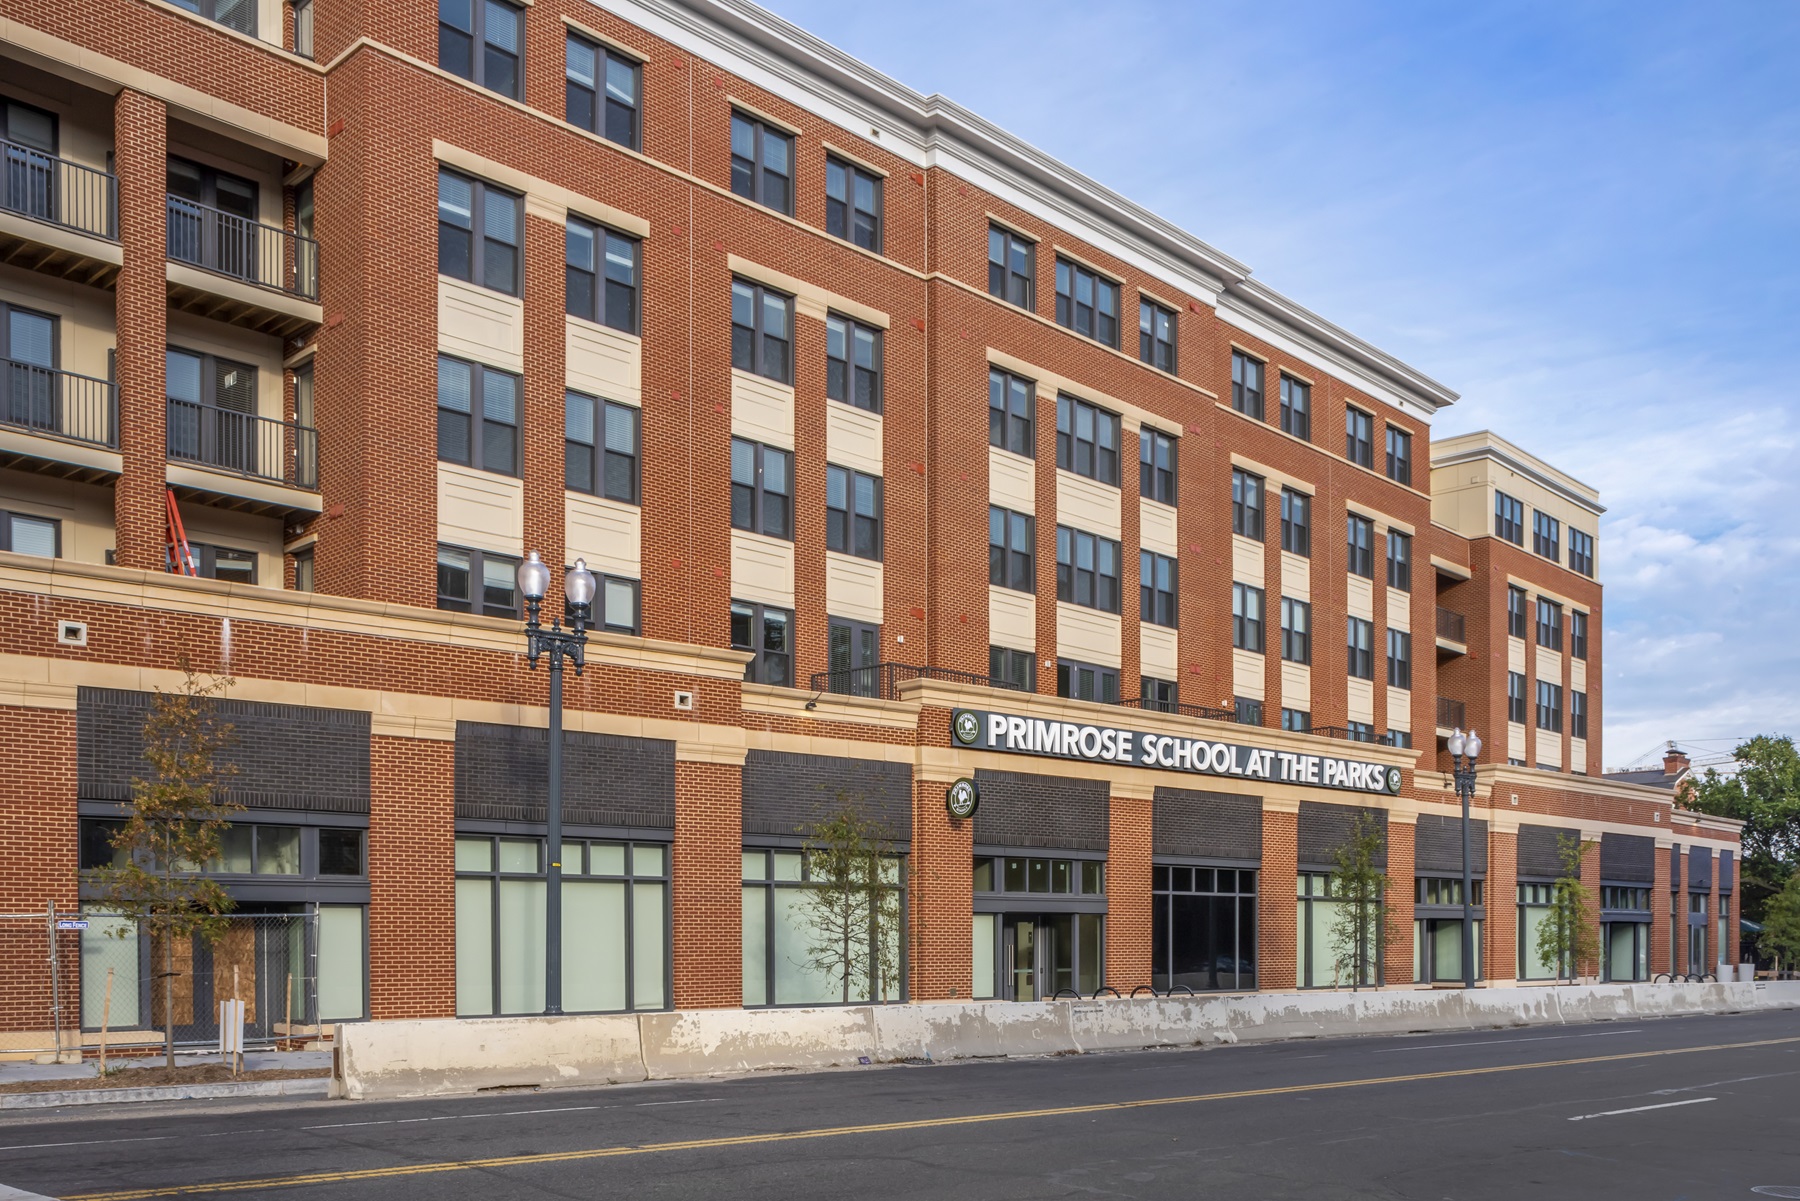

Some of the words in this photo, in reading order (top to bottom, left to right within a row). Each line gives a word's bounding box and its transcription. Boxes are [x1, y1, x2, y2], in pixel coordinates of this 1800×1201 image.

[988, 714, 1133, 762] PRIMROSE
[1140, 734, 1243, 774] SCHOOL
[1244, 749, 1275, 778] AT
[1278, 752, 1320, 783] THE
[1323, 758, 1385, 791] PARKS
